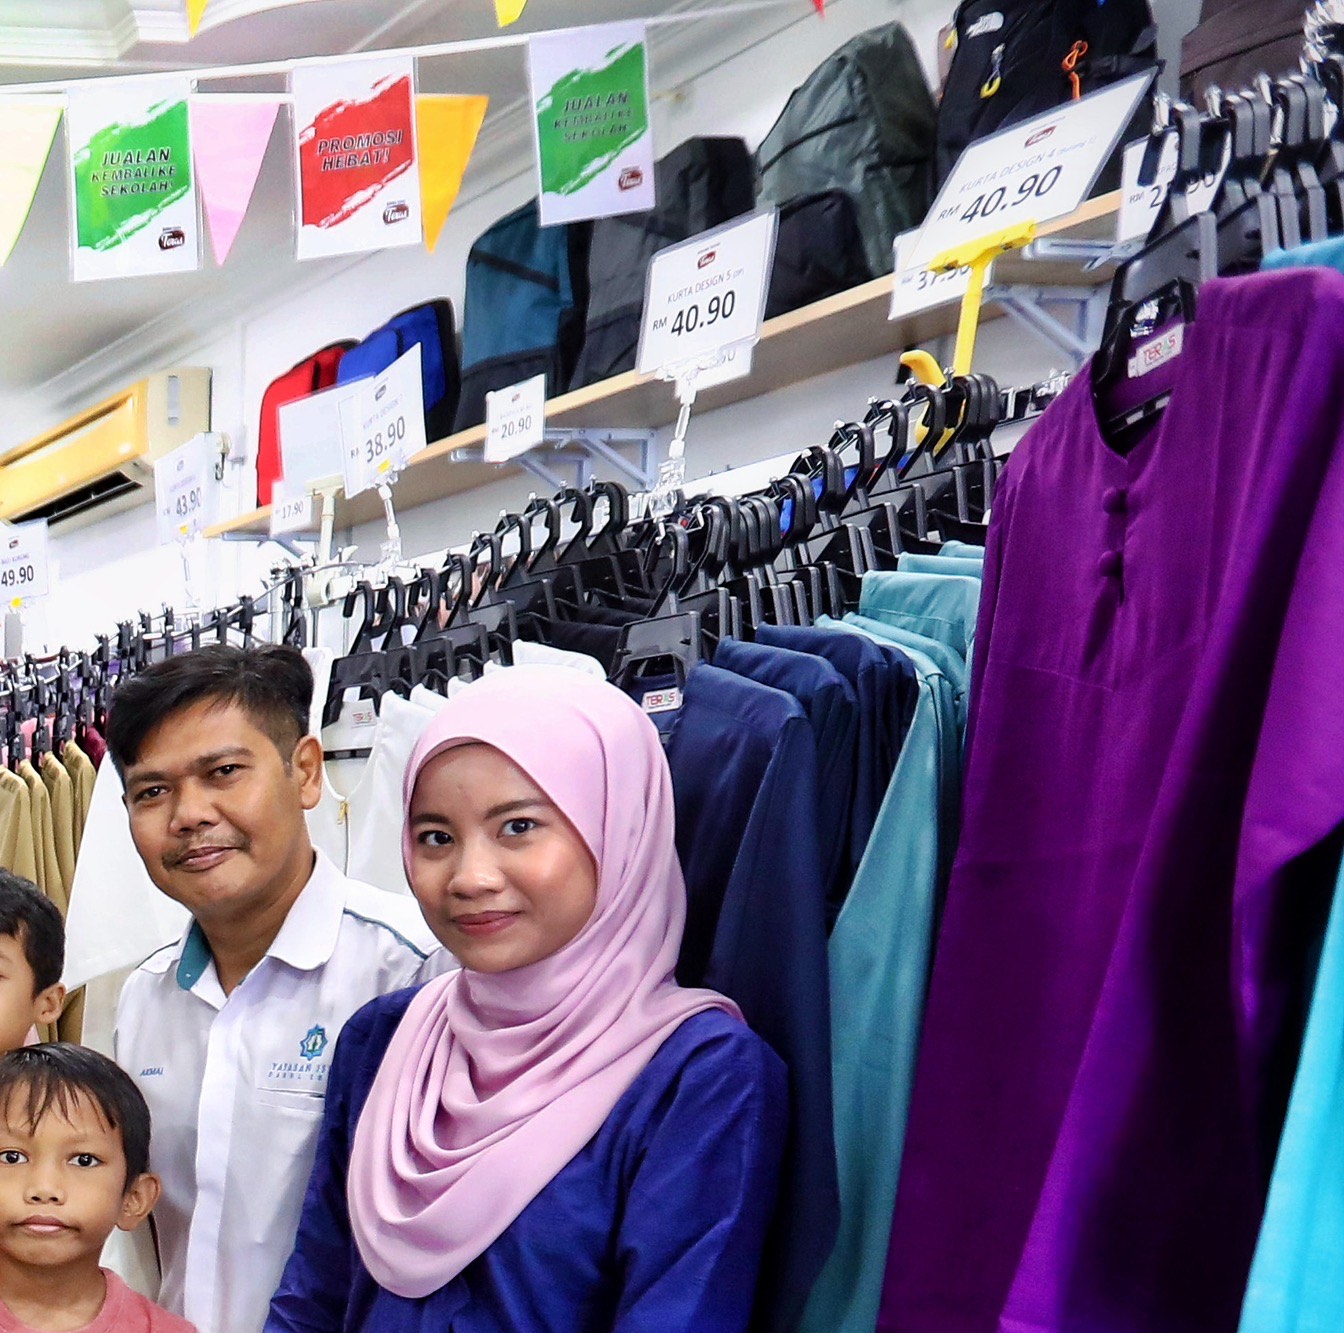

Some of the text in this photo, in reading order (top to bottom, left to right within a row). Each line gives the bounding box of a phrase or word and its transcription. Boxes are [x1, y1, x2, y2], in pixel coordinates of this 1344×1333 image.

[317, 130, 403, 154] PROMOSI
[101, 147, 171, 166] JUALAN
[321, 149, 391, 171] HEBAT!
[92, 164, 177, 183] KEMBALI KE
[937, 165, 1062, 224] RM 40.90
[653, 290, 735, 337] RM 40.90
[367, 415, 405, 463] 38.90
[501, 415, 532, 439] 20.90
[1, 565, 34, 587] 49.90
